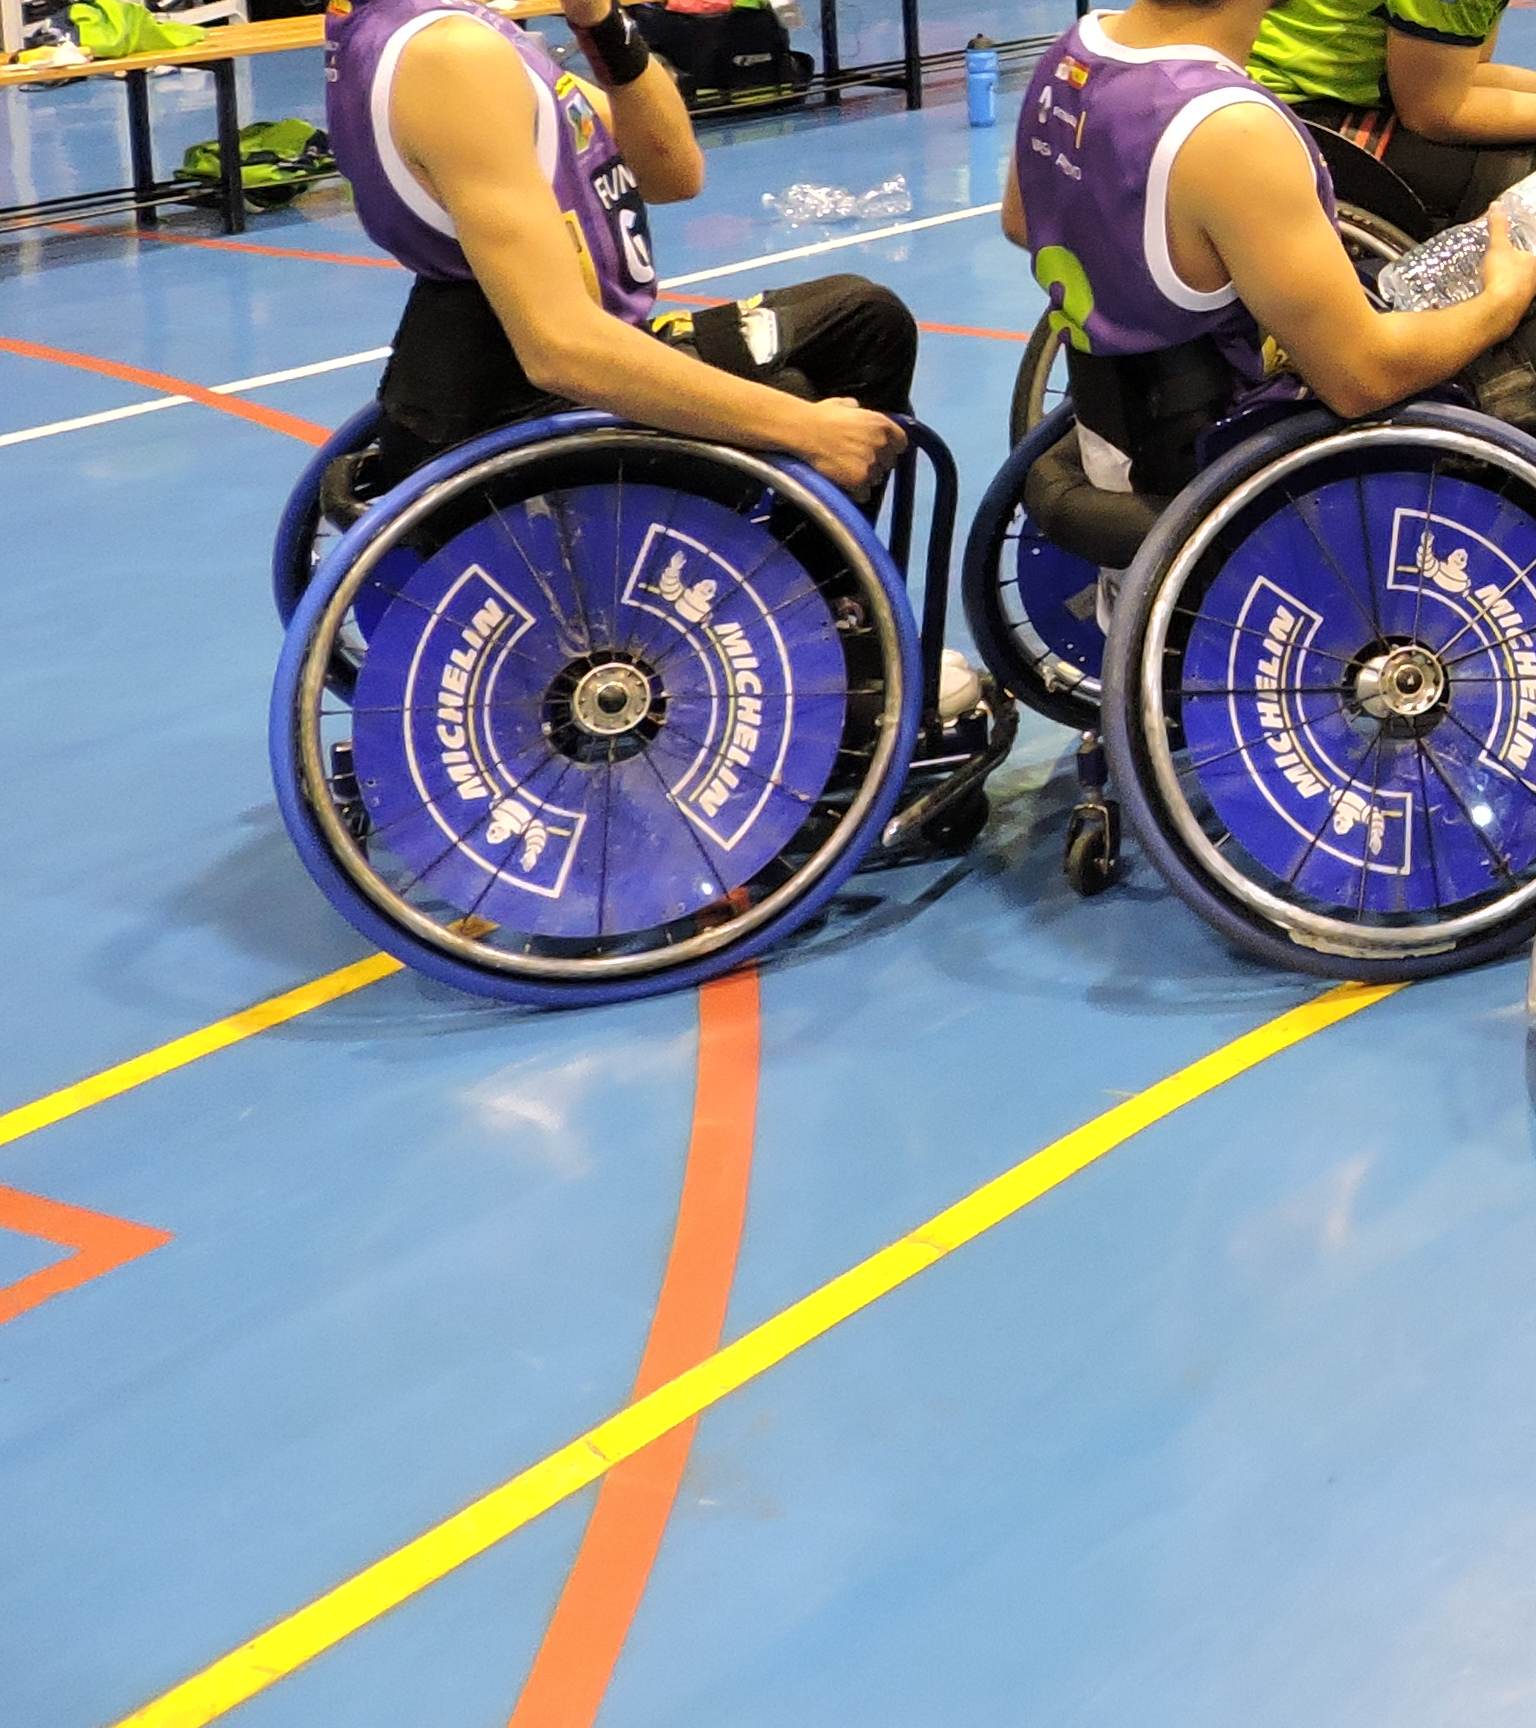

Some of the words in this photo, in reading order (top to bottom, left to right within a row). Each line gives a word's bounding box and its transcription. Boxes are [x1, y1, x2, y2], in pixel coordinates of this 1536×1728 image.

[434, 597, 516, 803] MICHELIN
[698, 619, 765, 819] MICHELIN
[1256, 604, 1331, 800] MICHELIN
